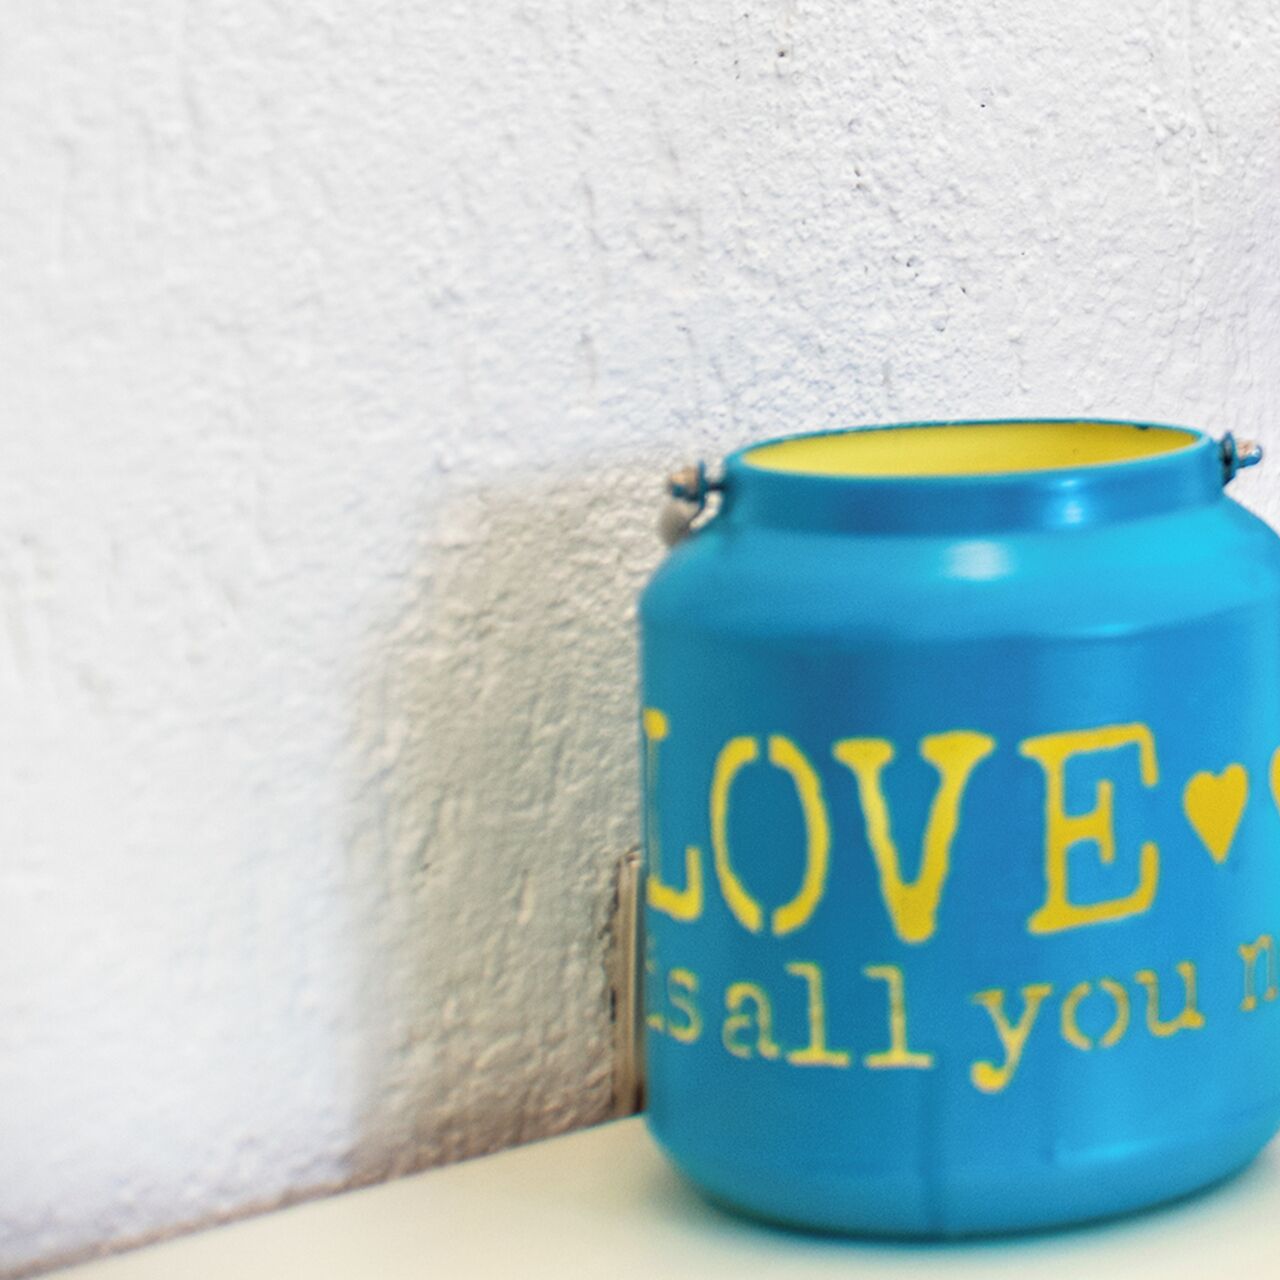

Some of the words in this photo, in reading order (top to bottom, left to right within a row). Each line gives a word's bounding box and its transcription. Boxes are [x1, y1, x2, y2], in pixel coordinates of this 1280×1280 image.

[643, 706, 1160, 944] LOVE
[721, 960, 935, 1068] all
[969, 958, 1207, 1095] you
